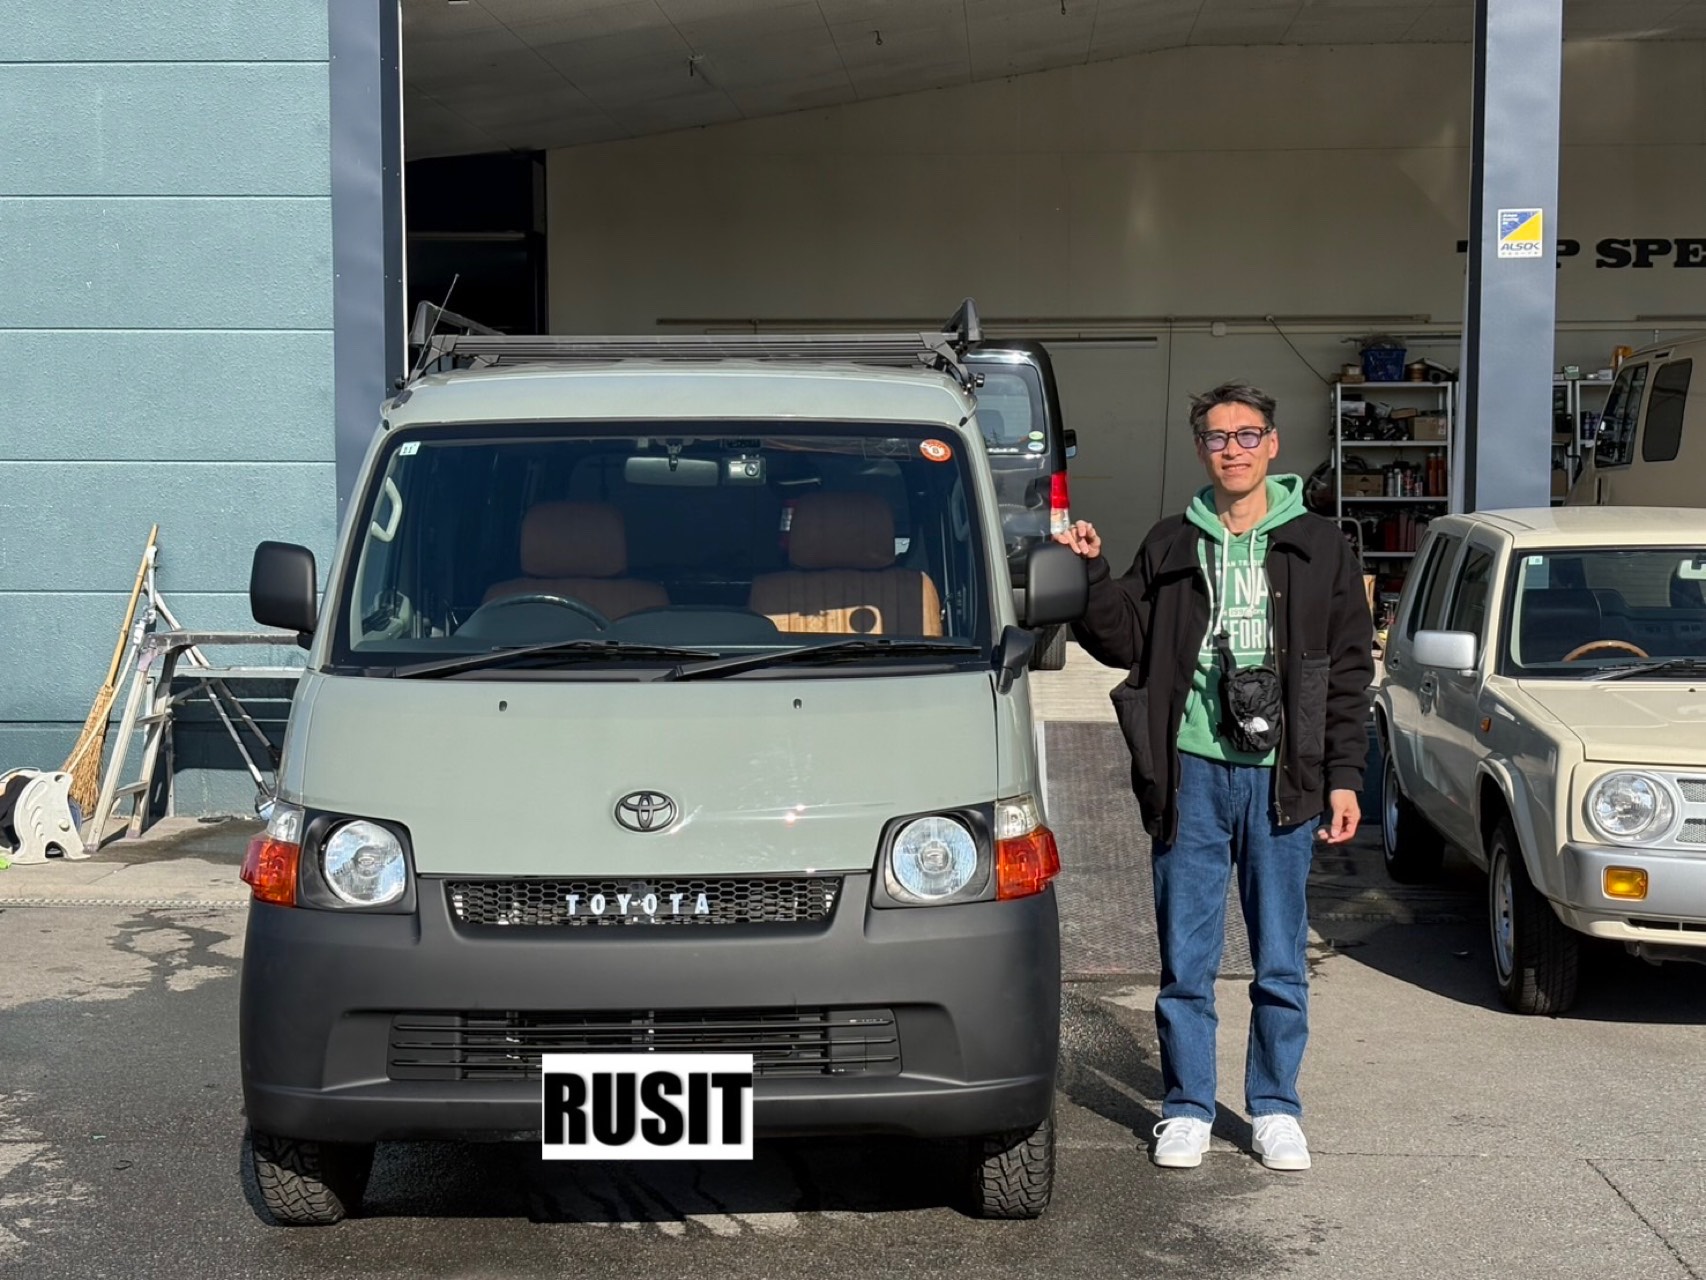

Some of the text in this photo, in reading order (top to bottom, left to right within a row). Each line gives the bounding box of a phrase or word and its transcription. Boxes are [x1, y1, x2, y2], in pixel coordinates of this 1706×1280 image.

[1501, 242, 1540, 251] ALSOK
[1596, 238, 1706, 268] SPE
[566, 892, 710, 916] TOYOTA
